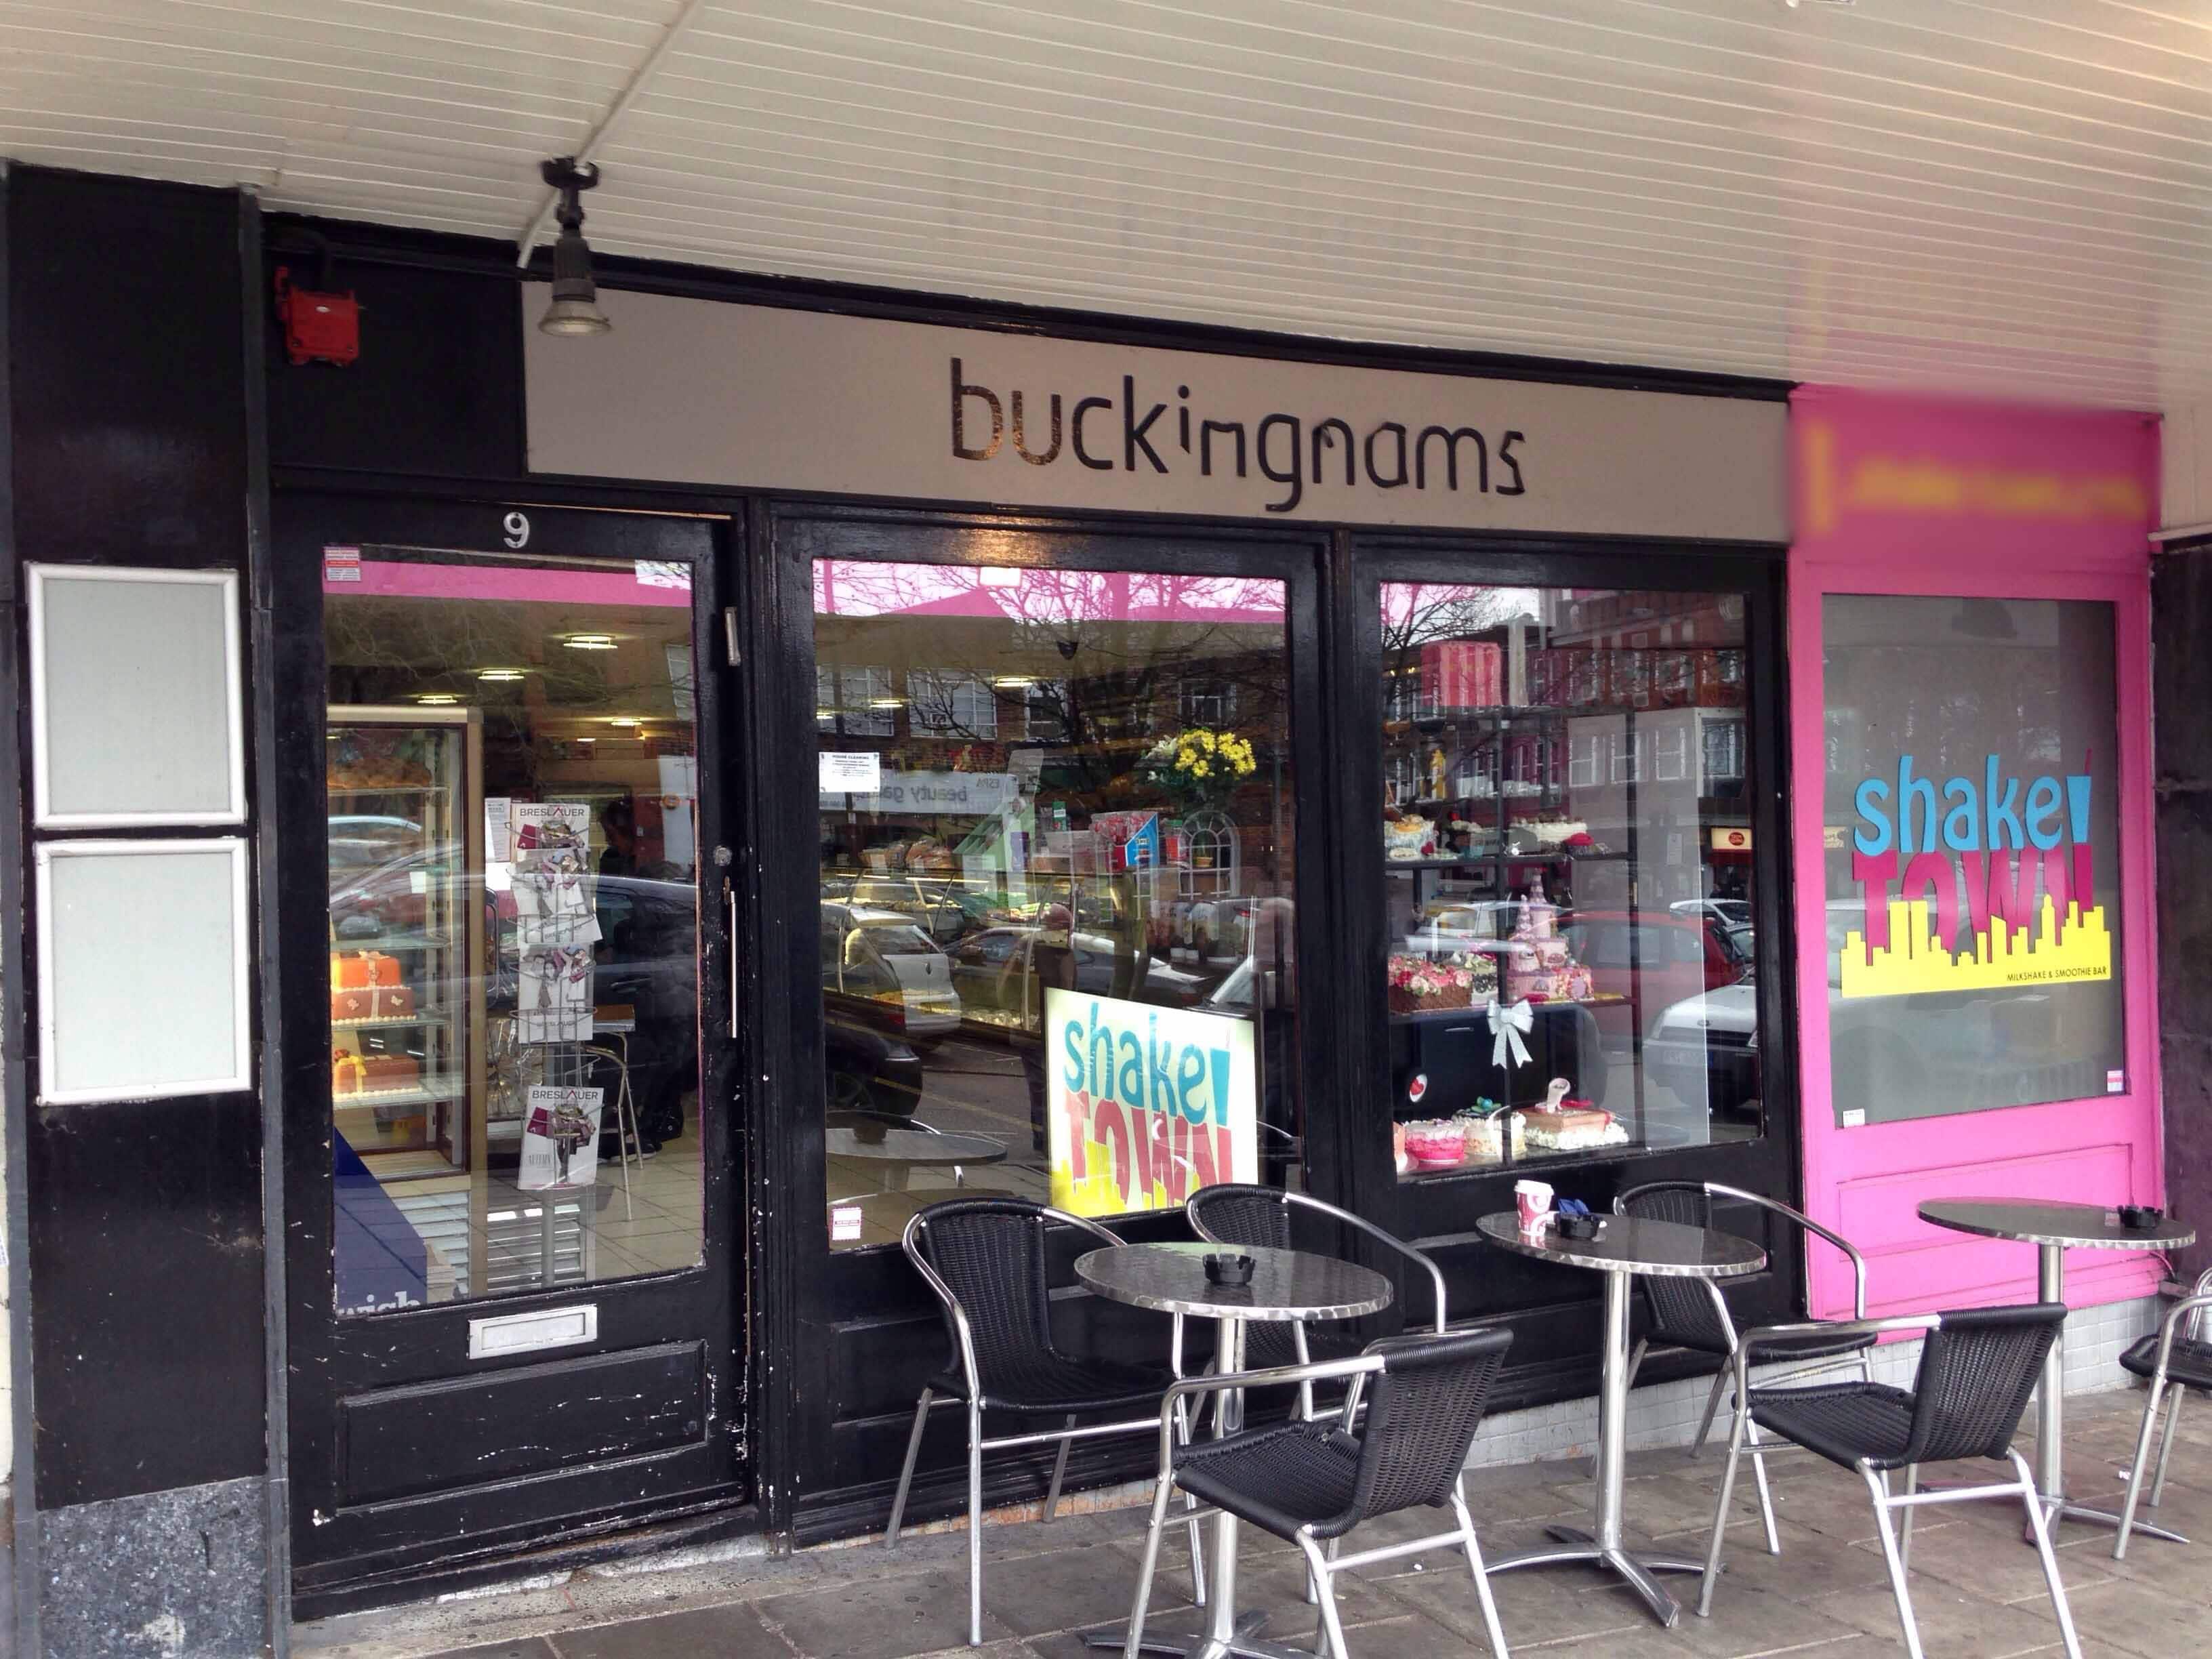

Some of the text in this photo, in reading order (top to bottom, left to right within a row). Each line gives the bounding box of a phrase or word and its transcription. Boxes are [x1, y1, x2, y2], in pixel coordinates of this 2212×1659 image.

[503, 512, 529, 548] 9
[520, 806, 585, 817] BRESLAUER
[1852, 843, 2093, 966] TOWN
[2007, 970, 2046, 982] MILKSHAKE
[2055, 967, 2091, 978] SMOOTHIE
[2093, 966, 2107, 975] BAR
[531, 1089, 598, 1101] BRESLAUER
[1065, 1090, 1233, 1208] TOWN
